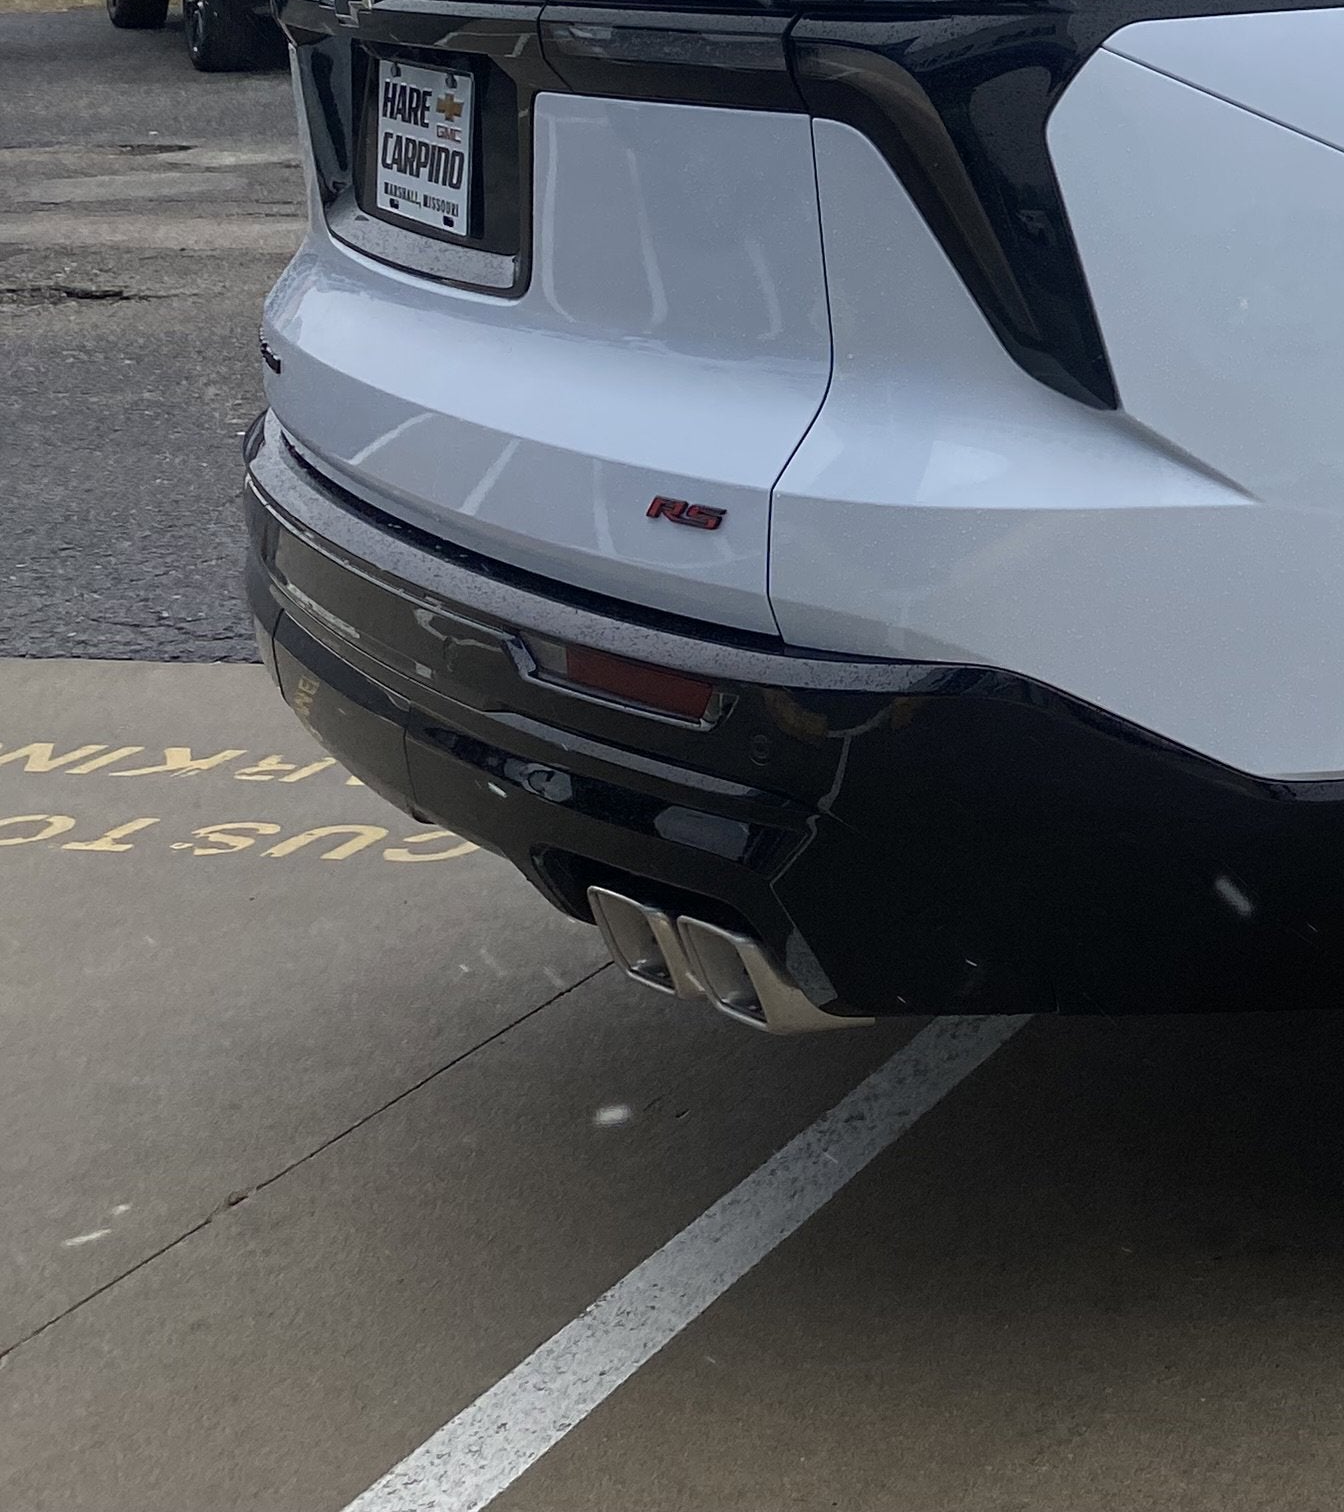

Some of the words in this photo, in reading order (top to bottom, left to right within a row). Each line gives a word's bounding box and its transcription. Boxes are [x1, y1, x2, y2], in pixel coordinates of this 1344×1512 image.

[381, 81, 433, 128] HARE
[436, 124, 463, 143] GMC
[381, 131, 465, 189] CARPINO
[423, 194, 459, 217] MISSOURI
[646, 495, 727, 530] RS
